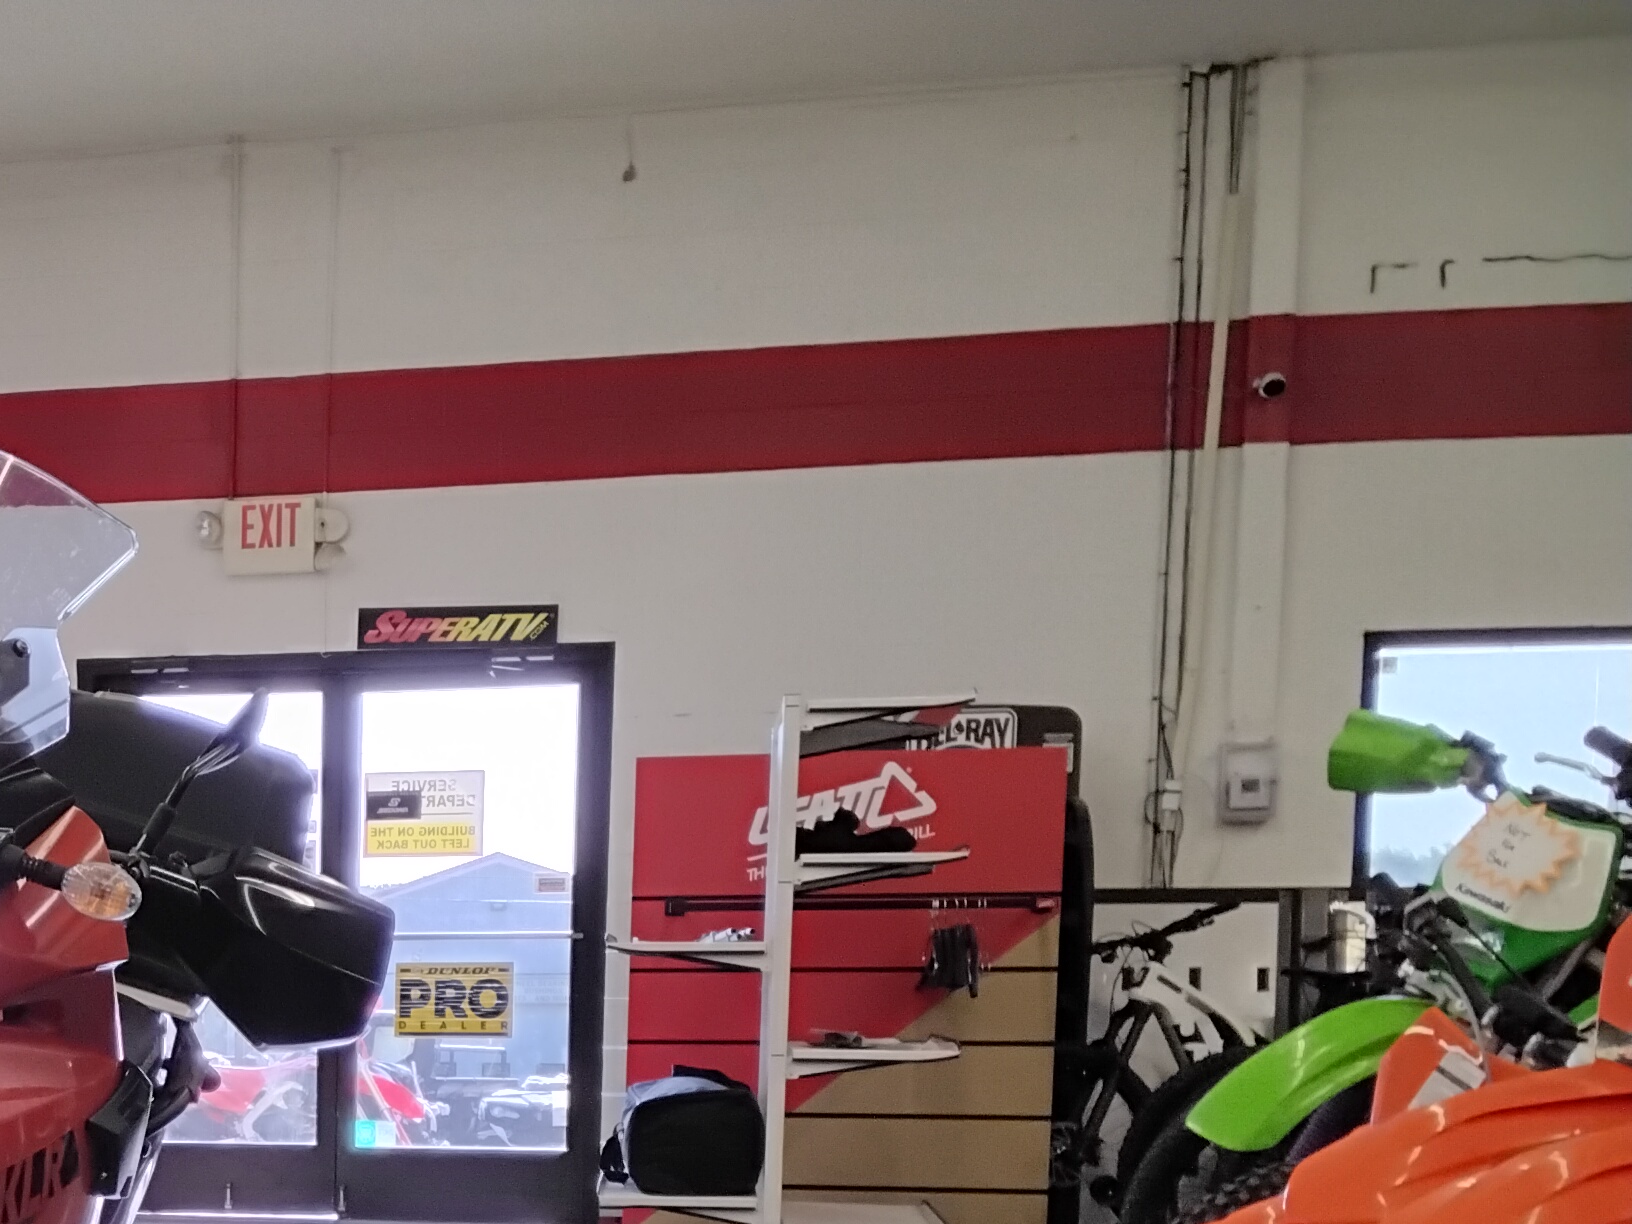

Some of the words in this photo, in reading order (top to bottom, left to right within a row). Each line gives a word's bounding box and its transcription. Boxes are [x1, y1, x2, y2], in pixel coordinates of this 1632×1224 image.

[241, 503, 302, 549] EXIT
[747, 866, 766, 882] TH
[426, 966, 496, 976] DUNLOP
[399, 978, 509, 1019] PRO
[399, 1020, 508, 1031] DEALER
